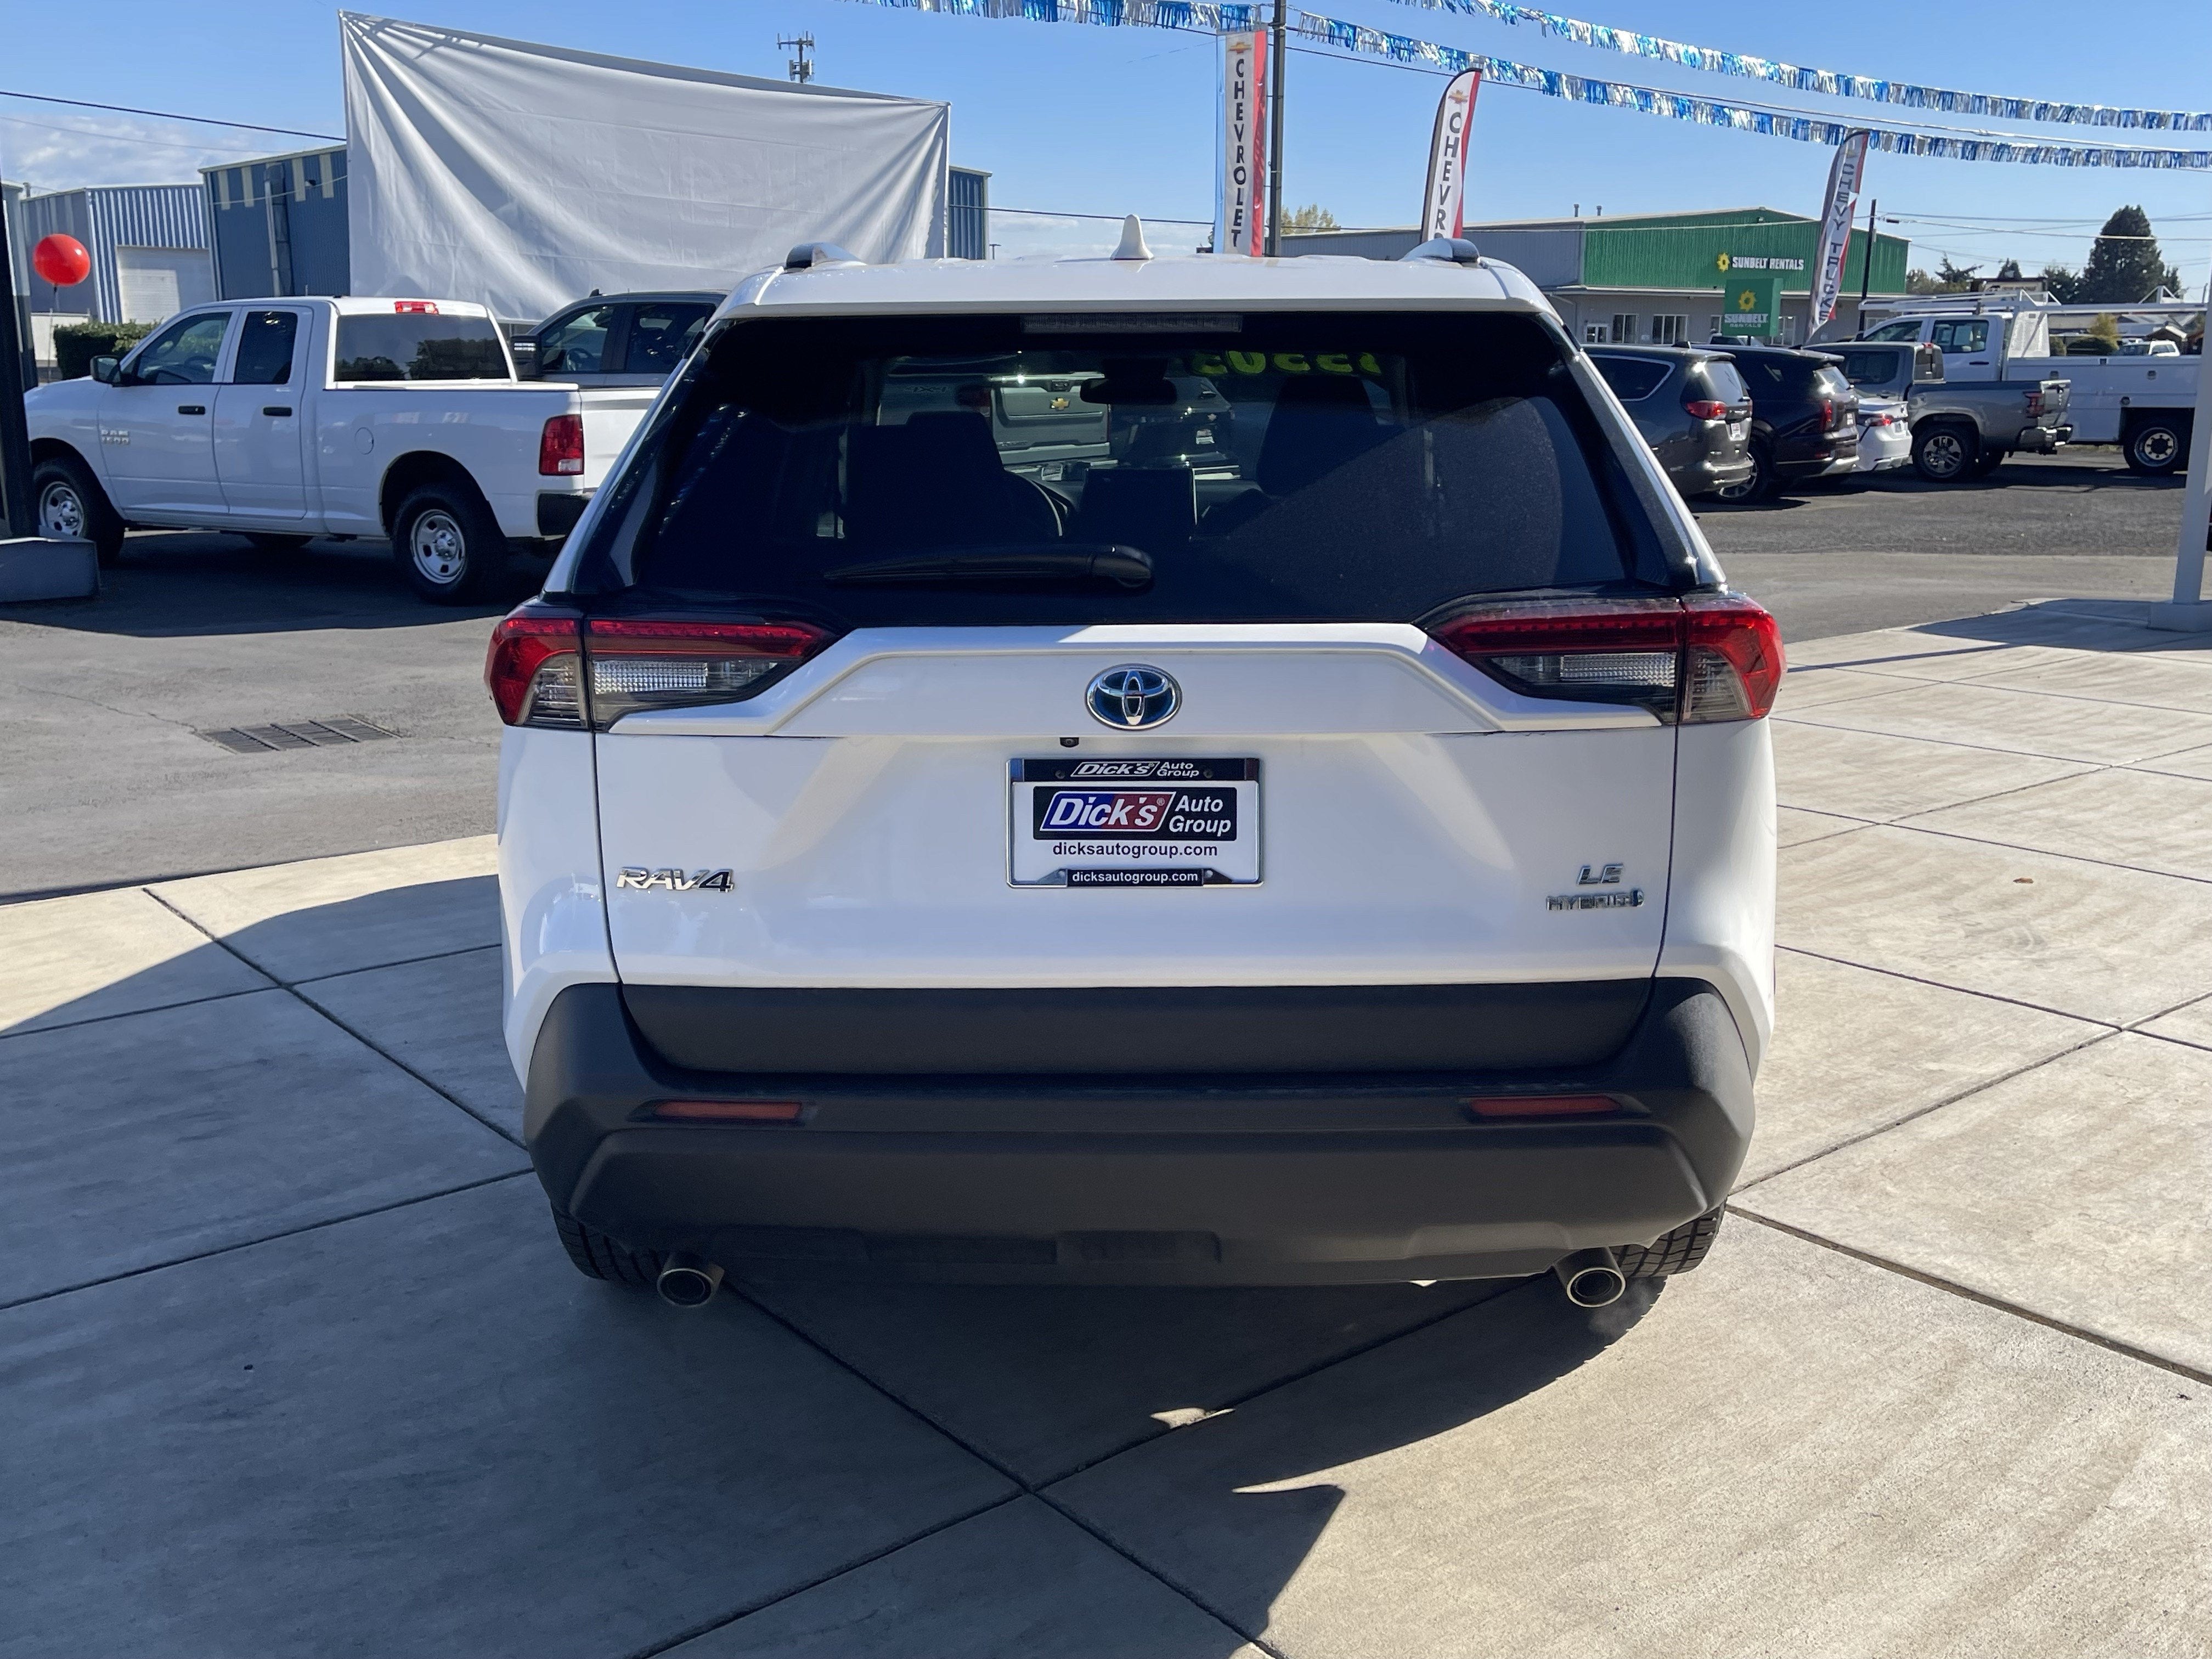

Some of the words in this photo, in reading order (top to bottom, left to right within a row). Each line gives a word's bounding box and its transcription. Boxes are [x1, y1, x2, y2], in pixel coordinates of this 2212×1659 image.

[1231, 58, 1247, 247] CHEVROLET
[1434, 111, 1462, 239] CHEVR
[1732, 256, 1768, 269] SUNBELT
[1769, 258, 1804, 270] RENTALS
[1724, 313, 1768, 323] SUNBELT
[1077, 762, 1151, 775] Dick's
[1156, 769, 1200, 778] Group
[1049, 796, 1159, 826] Dick's
[1175, 795, 1223, 812] Auto
[1169, 815, 1232, 837] Group
[1052, 842, 1218, 859] dicksautogroup.com
[616, 866, 735, 893] RAV4
[1071, 871, 1198, 884] dicksautogroup.com
[1576, 863, 1624, 885] LE
